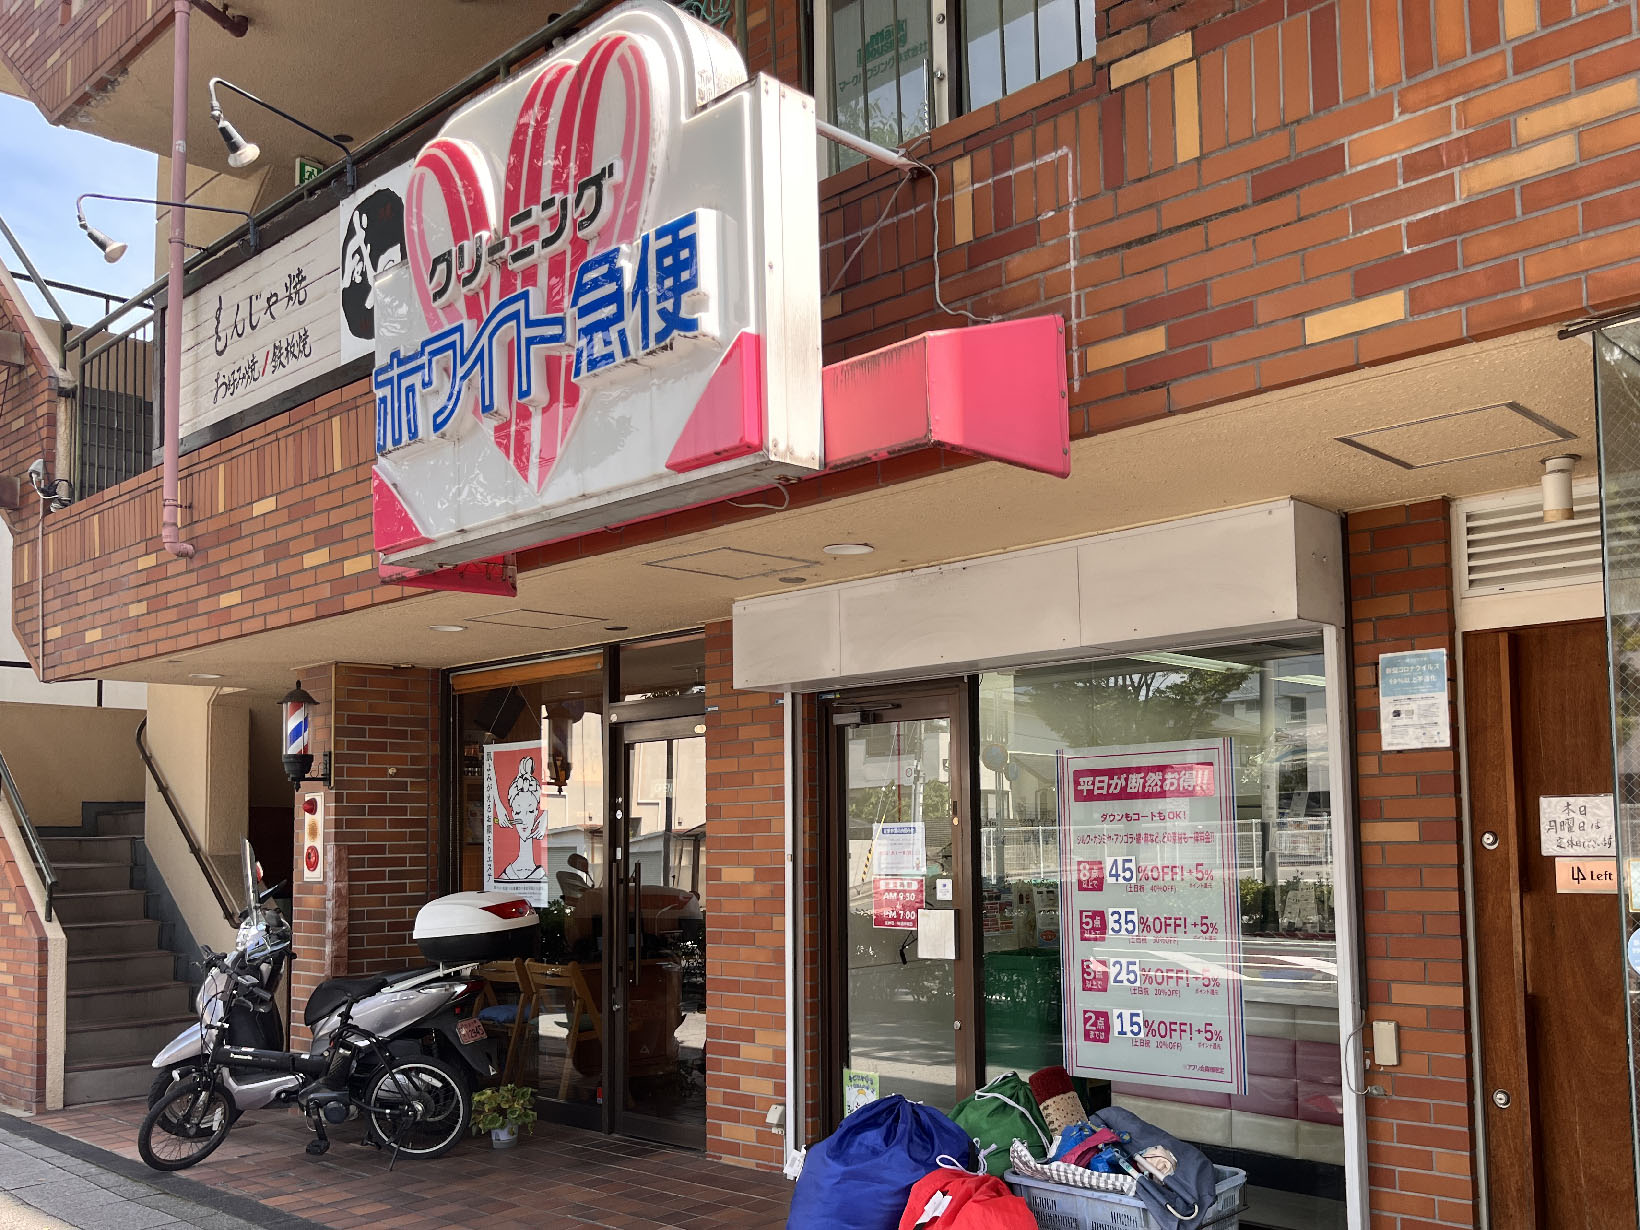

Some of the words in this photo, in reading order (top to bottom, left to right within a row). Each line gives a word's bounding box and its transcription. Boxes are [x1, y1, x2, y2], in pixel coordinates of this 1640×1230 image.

[429, 160, 616, 303] クリーニング
[215, 267, 307, 356] もんじゃ焼
[374, 211, 698, 455] ホワイト急便
[1077, 770, 1209, 796] 平日が断然お得!!
[1562, 801, 1587, 817] 本日
[1546, 817, 1601, 833] 月曜日は
[1591, 871, 1613, 881] Left
[899, 893, 916, 901] 9:30
[883, 911, 898, 919] PM
[899, 911, 916, 920] 7:00
